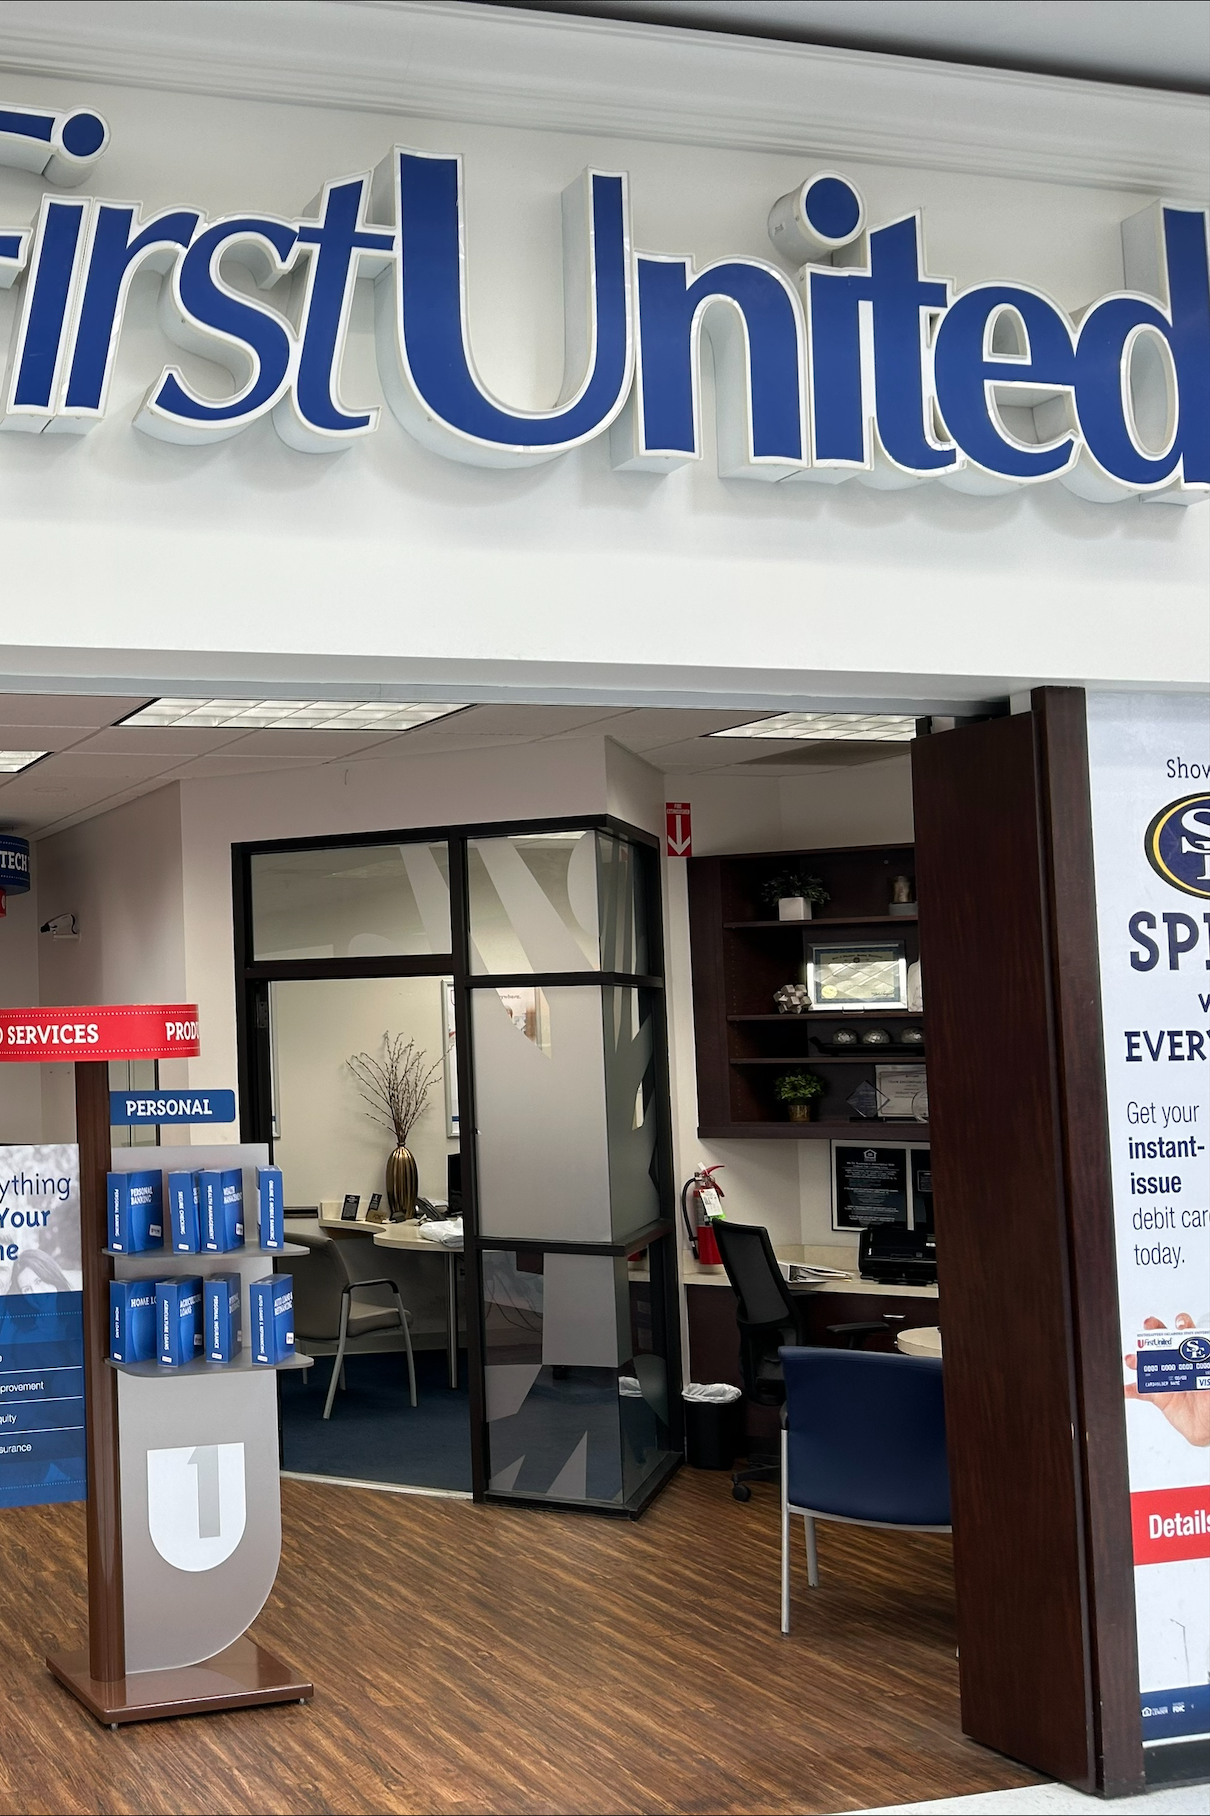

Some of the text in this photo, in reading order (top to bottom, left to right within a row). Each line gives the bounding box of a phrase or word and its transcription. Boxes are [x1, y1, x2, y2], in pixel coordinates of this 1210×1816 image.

[7, 1024, 99, 1045] SERVICES
[126, 1099, 213, 1116] PERSONAL
[1127, 1101, 1199, 1129] Get your
[1128, 1136, 1205, 1160] instant-
[130, 1186, 153, 1197] PERSONAL
[1130, 1172, 1182, 1195] issue
[130, 1195, 152, 1206] BANKING
[1132, 1207, 1210, 1230] debit car
[1133, 1242, 1185, 1269] today.
[130, 1296, 150, 1308] HOME
